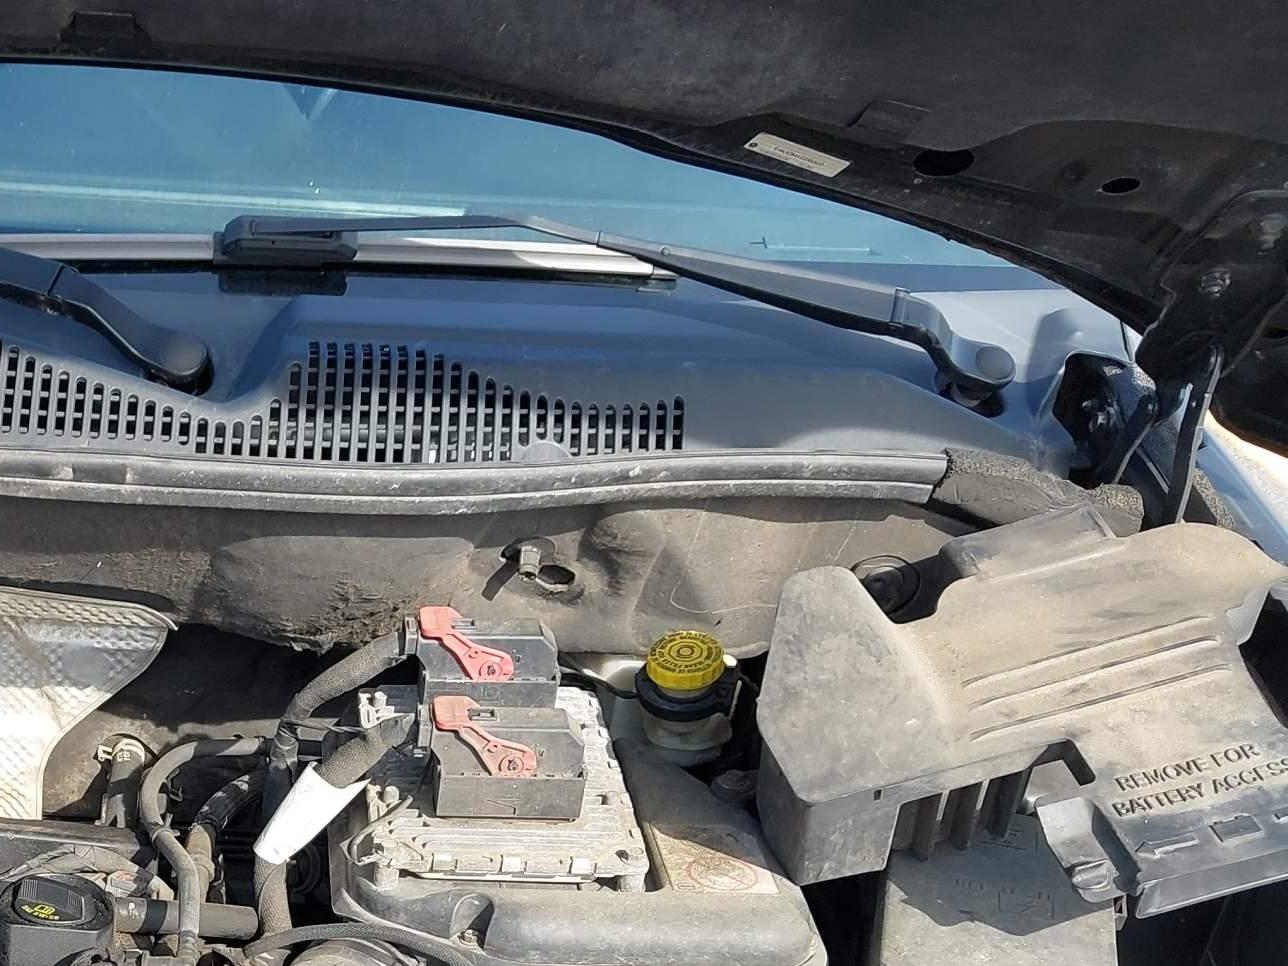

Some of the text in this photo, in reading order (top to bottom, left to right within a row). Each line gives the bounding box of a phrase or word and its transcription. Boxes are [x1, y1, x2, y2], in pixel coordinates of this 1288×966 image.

[1112, 757, 1288, 818] BATTERY ACCESS
[1114, 743, 1261, 792] REMOVE FOR
